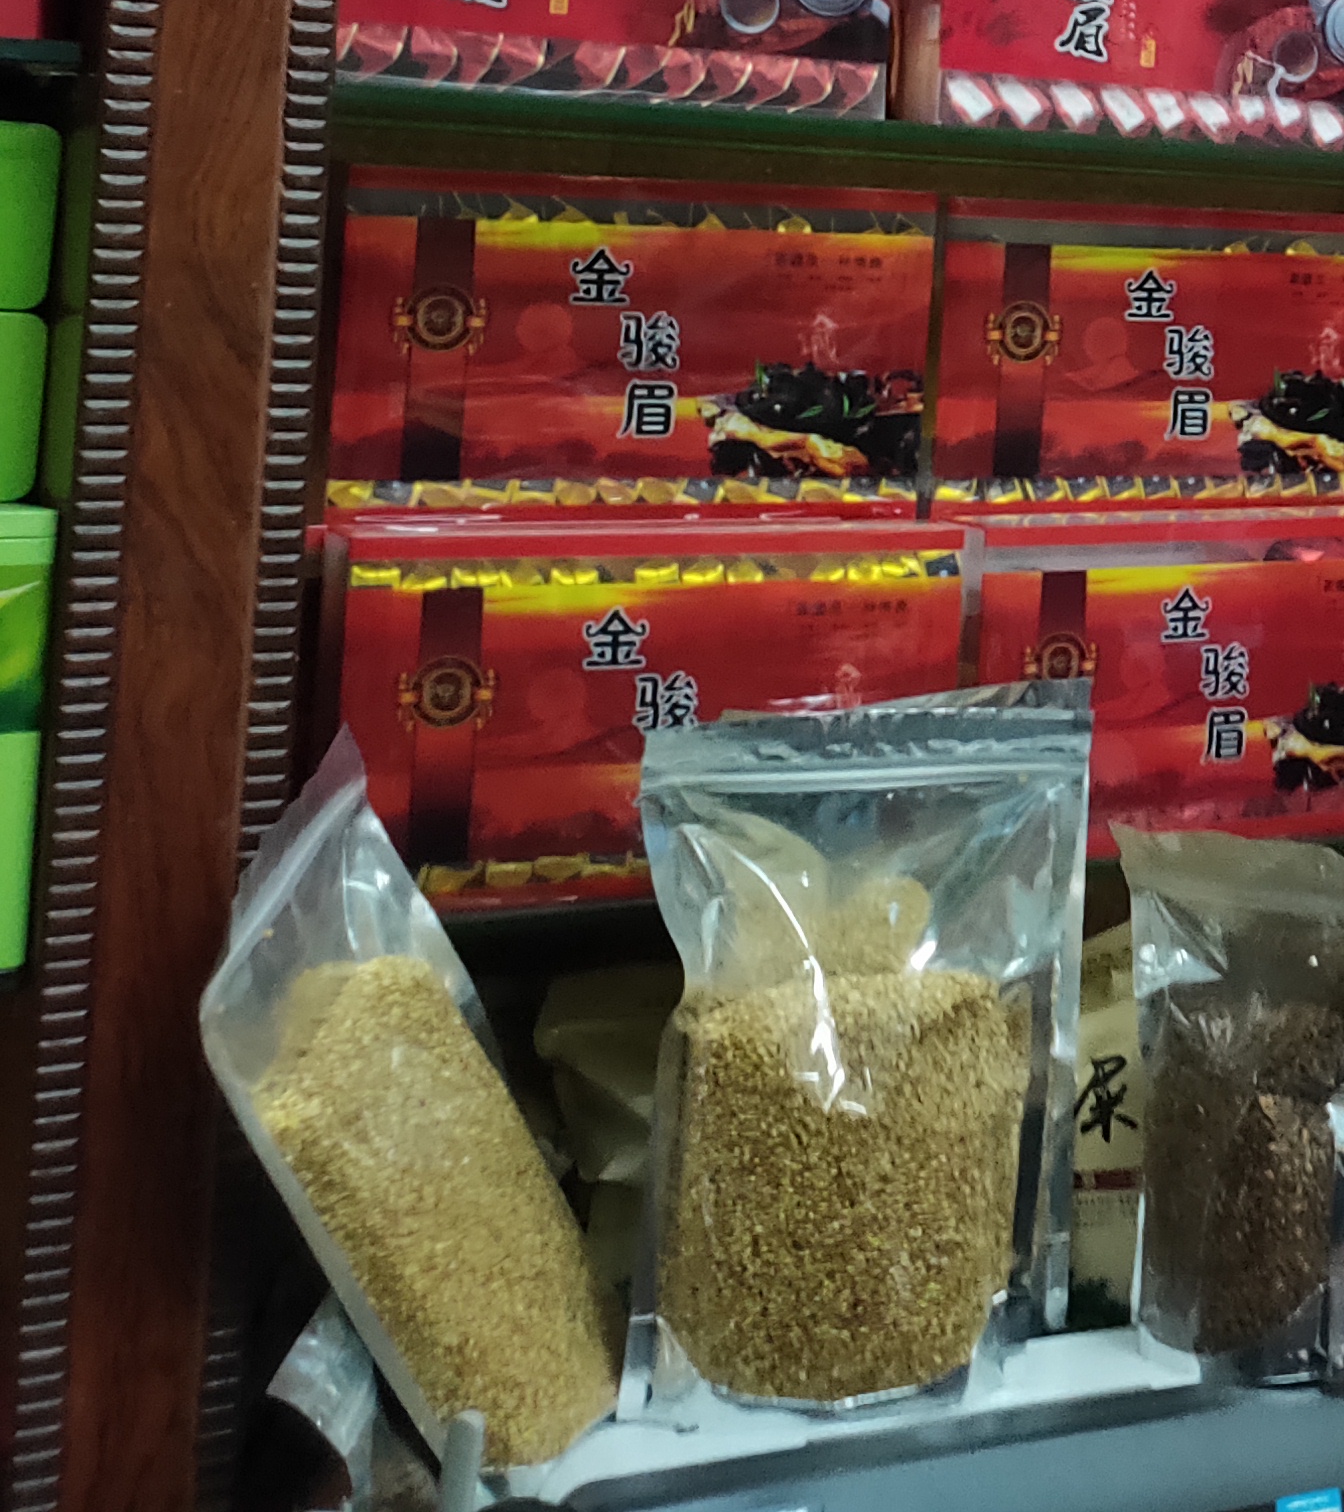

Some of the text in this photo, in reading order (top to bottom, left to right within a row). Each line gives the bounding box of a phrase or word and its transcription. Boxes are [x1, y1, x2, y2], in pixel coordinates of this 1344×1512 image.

[568, 245, 682, 439] 金骏眉
[1124, 267, 1215, 441] 金骏眉
[582, 605, 700, 732] 金骏
[1160, 586, 1249, 765] 金骏眉
